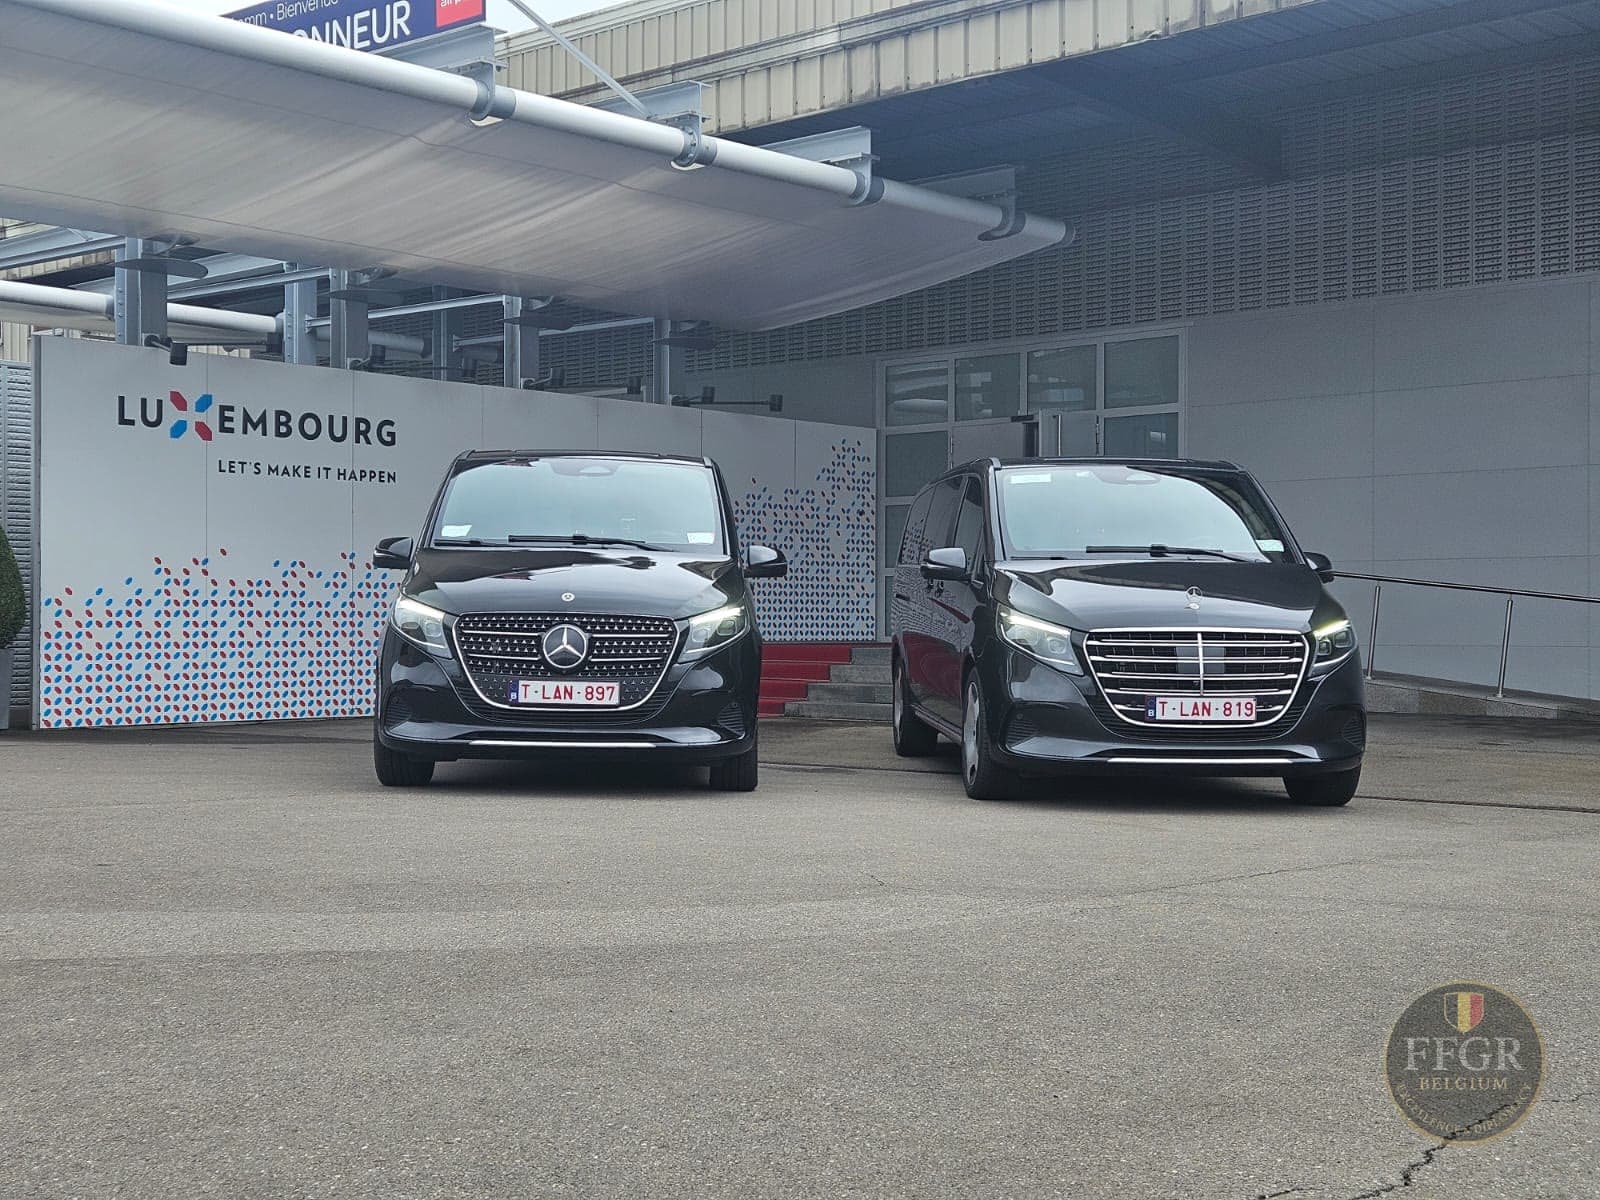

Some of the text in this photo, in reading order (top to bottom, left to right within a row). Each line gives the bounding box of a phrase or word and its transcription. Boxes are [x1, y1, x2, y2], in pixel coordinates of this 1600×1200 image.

[218, 459, 397, 484] LET'S MAKE IT HAPPEN
